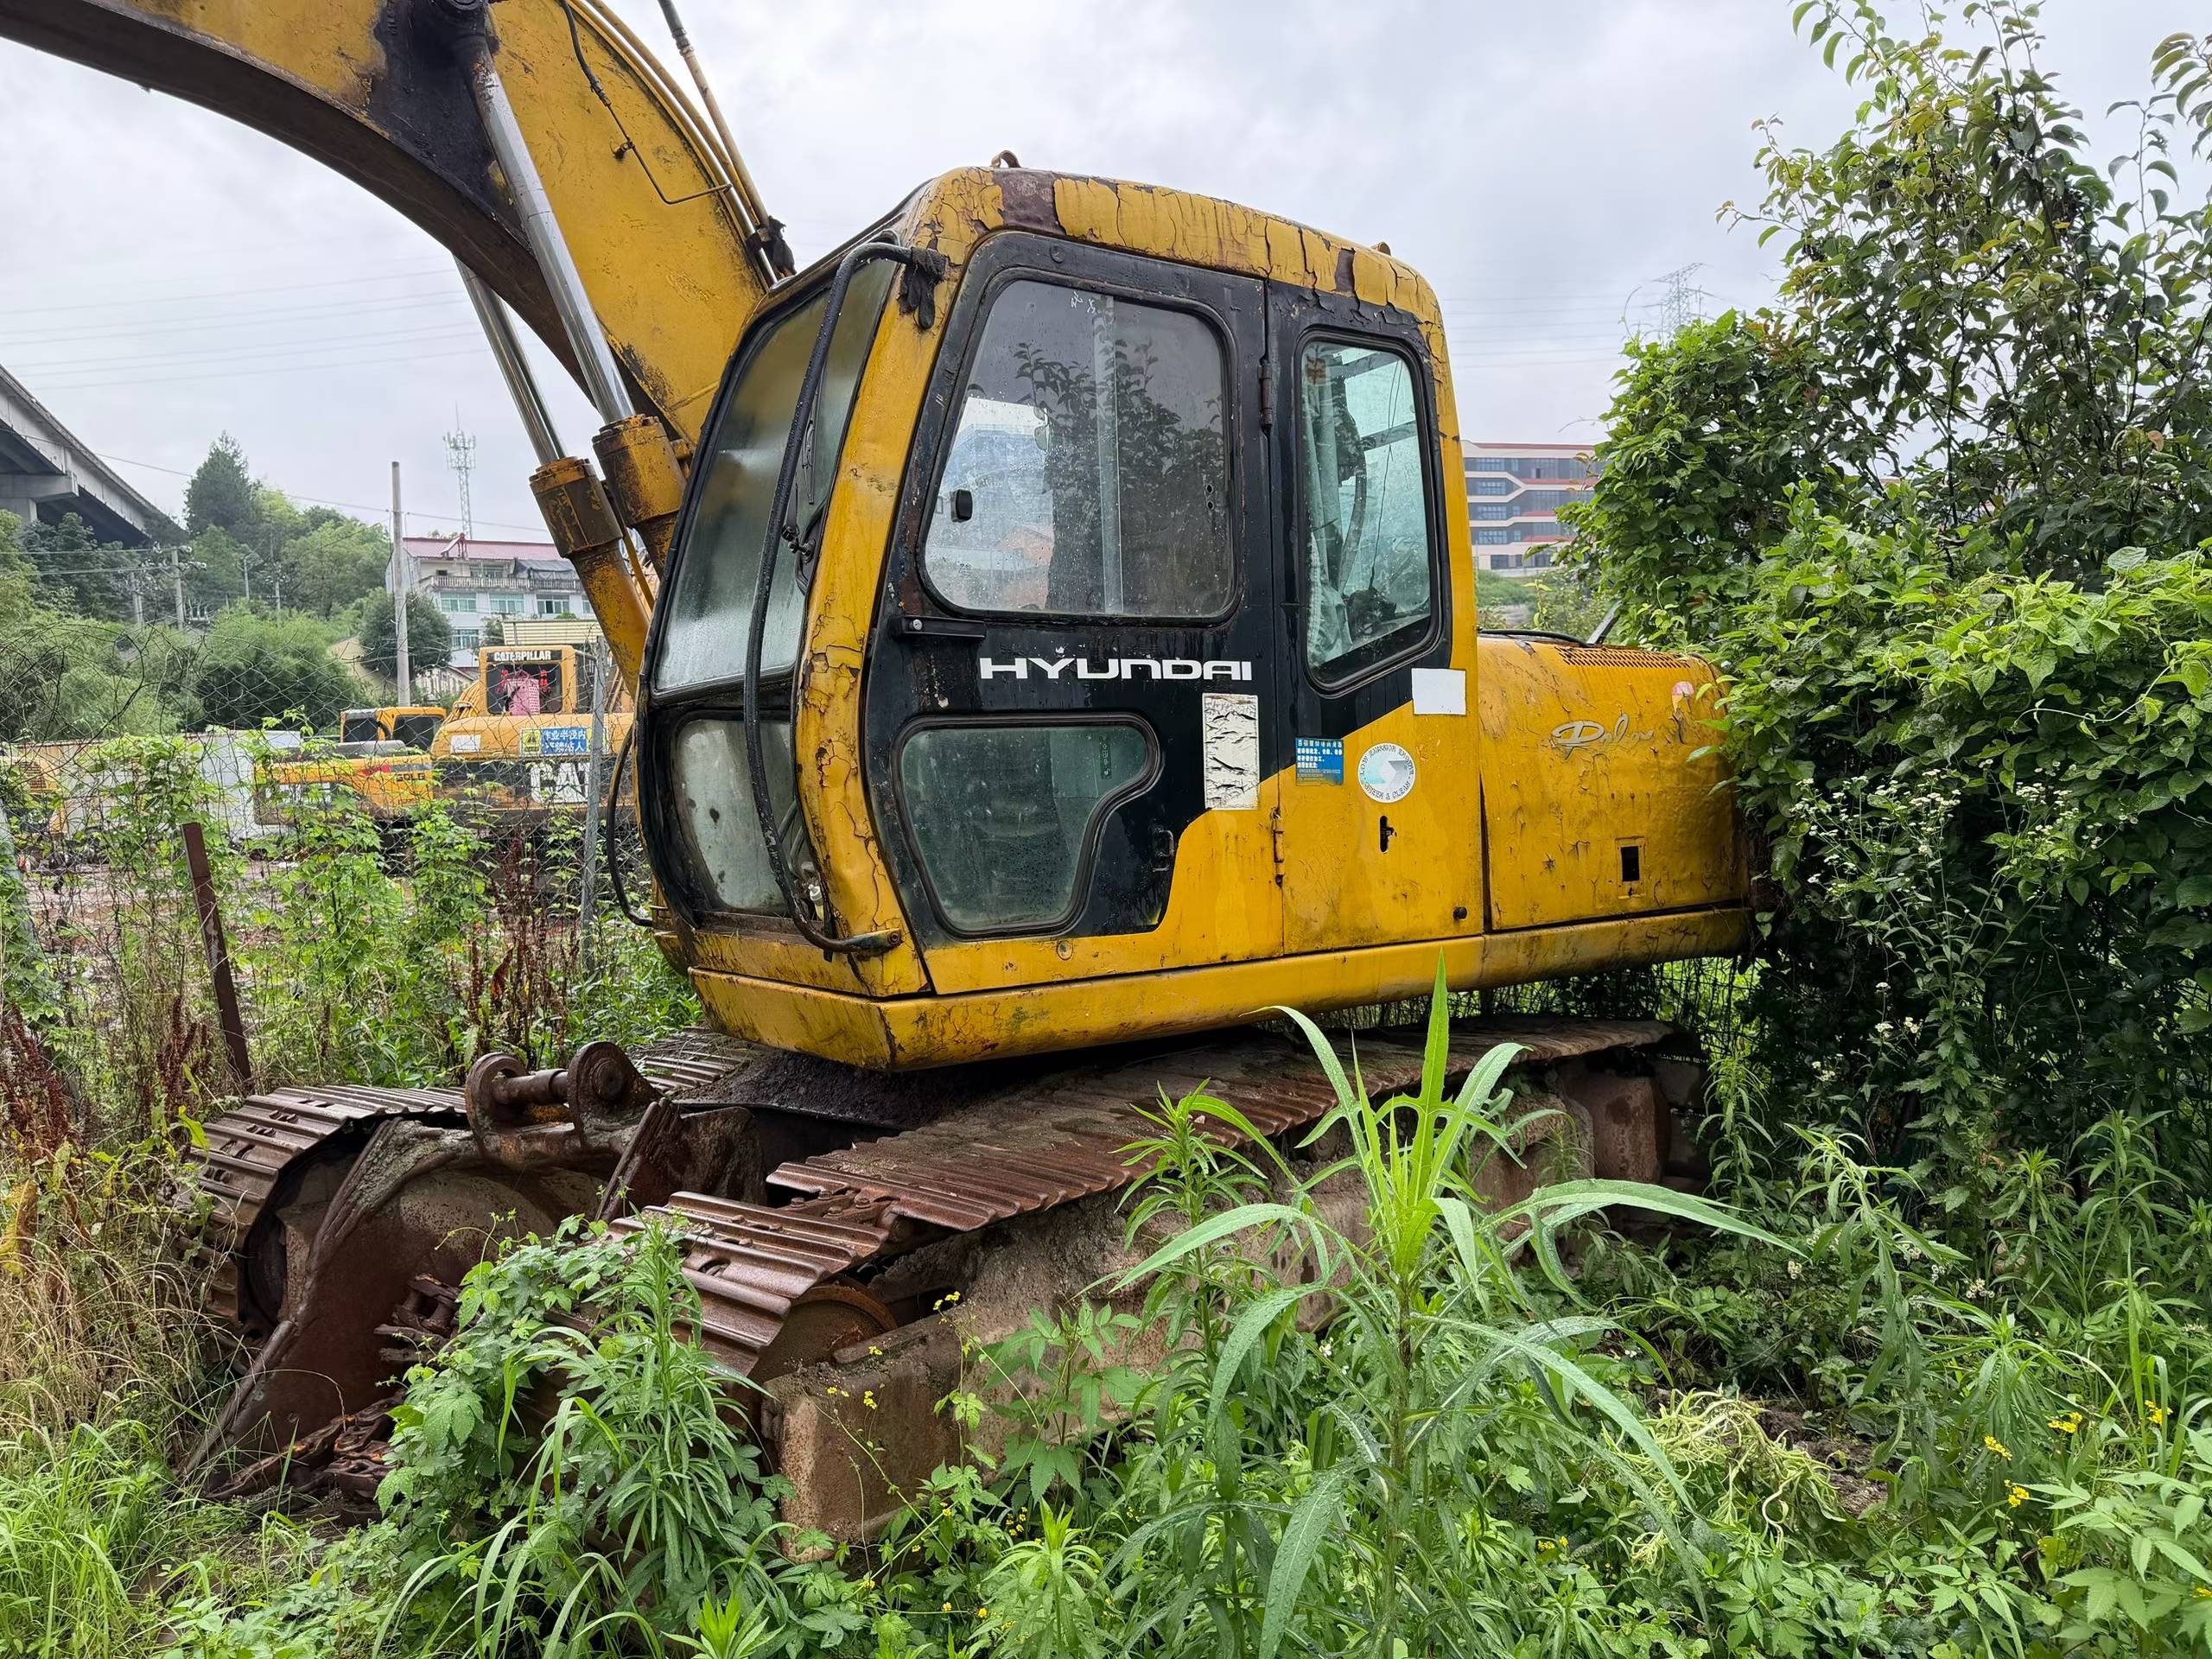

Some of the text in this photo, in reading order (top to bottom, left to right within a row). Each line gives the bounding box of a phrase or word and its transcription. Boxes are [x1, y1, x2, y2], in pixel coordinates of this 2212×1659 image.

[493, 650, 551, 662] CATERPILLAR
[979, 657, 1253, 681] HYUNDAI
[1360, 755, 1369, 775] LOW
